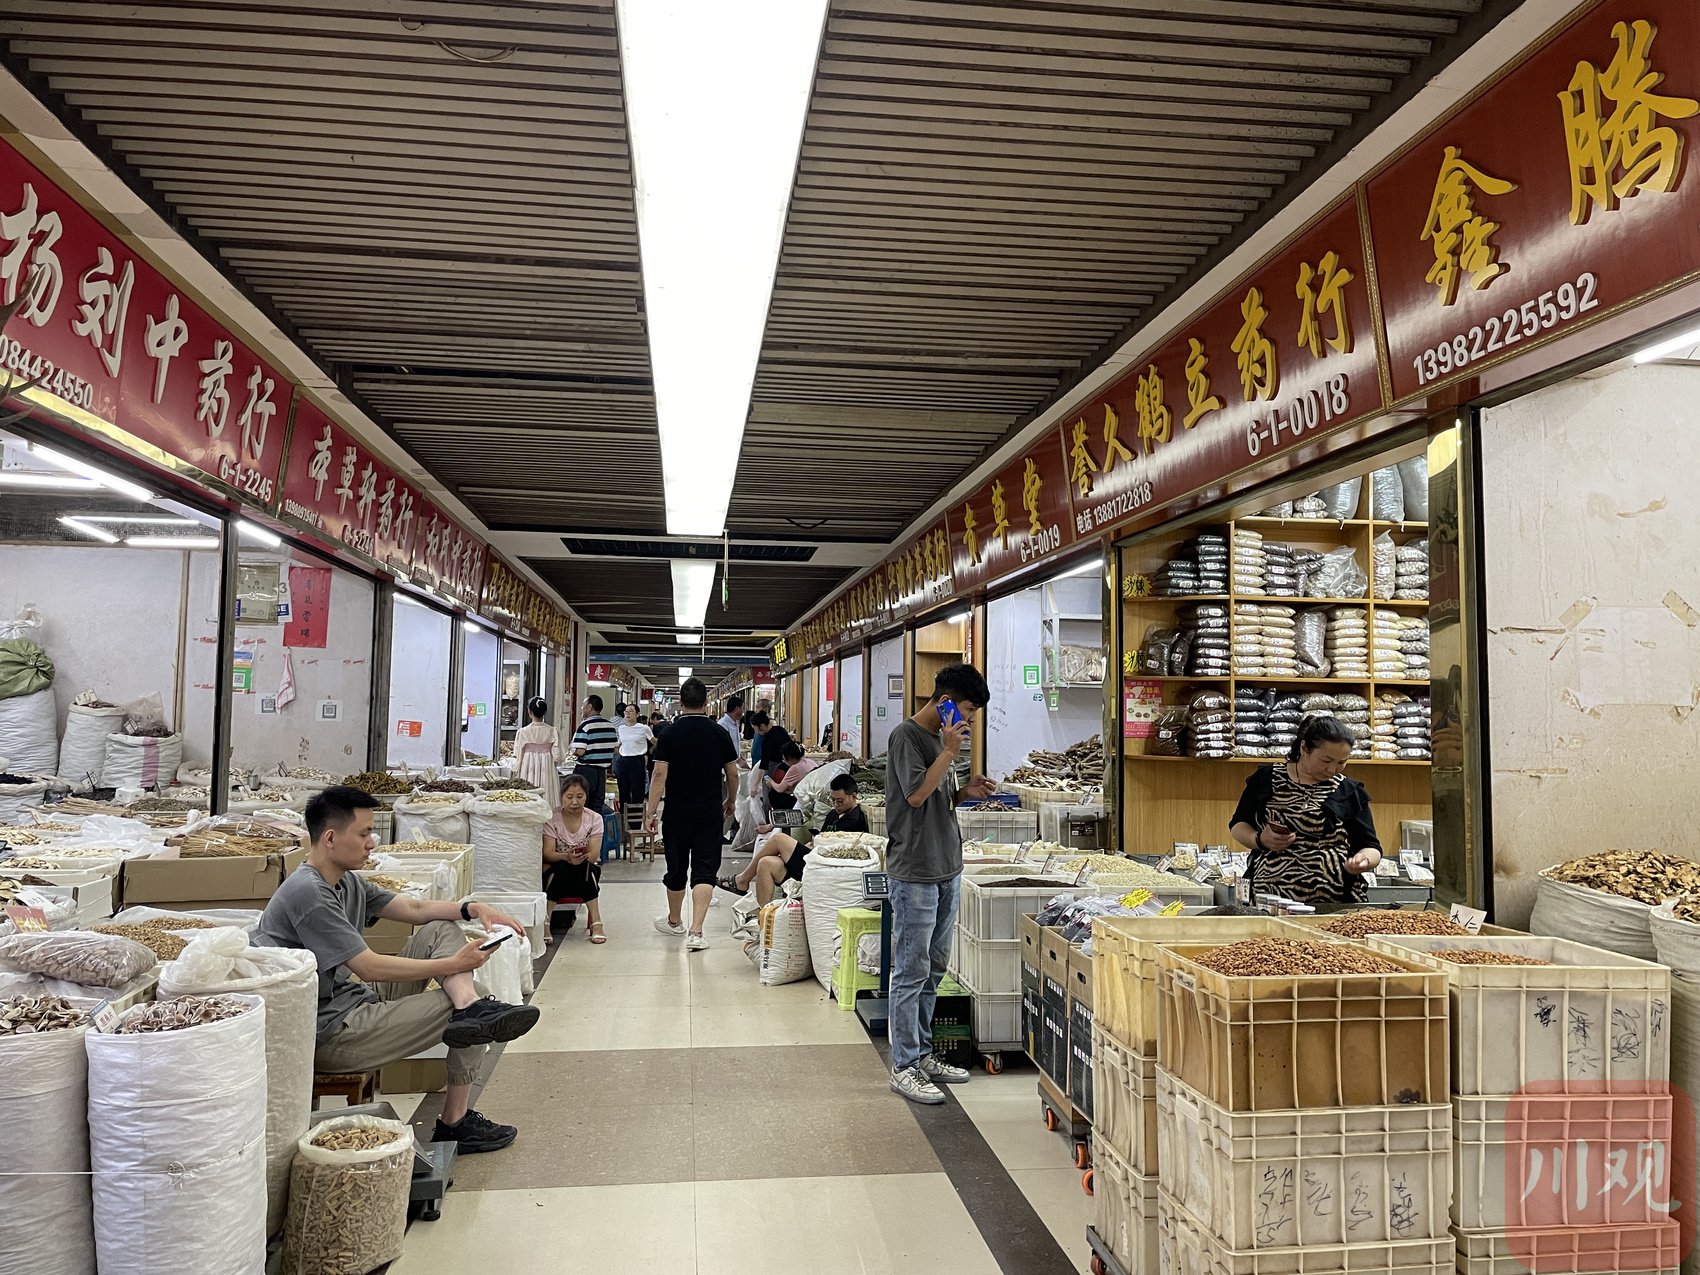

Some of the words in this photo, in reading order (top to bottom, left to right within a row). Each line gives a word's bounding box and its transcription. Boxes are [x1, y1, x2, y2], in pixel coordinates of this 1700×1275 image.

[1421, 19, 1700, 306] 鑫腾
[1413, 271, 1600, 386] 13982225592
[1246, 373, 1350, 457] 6-1-0018
[219, 454, 273, 503] 6-1-2245
[1076, 508, 1092, 535] 电话
[1093, 481, 1152, 527] 13881722818
[1020, 524, 1060, 563] 6-1-0019
